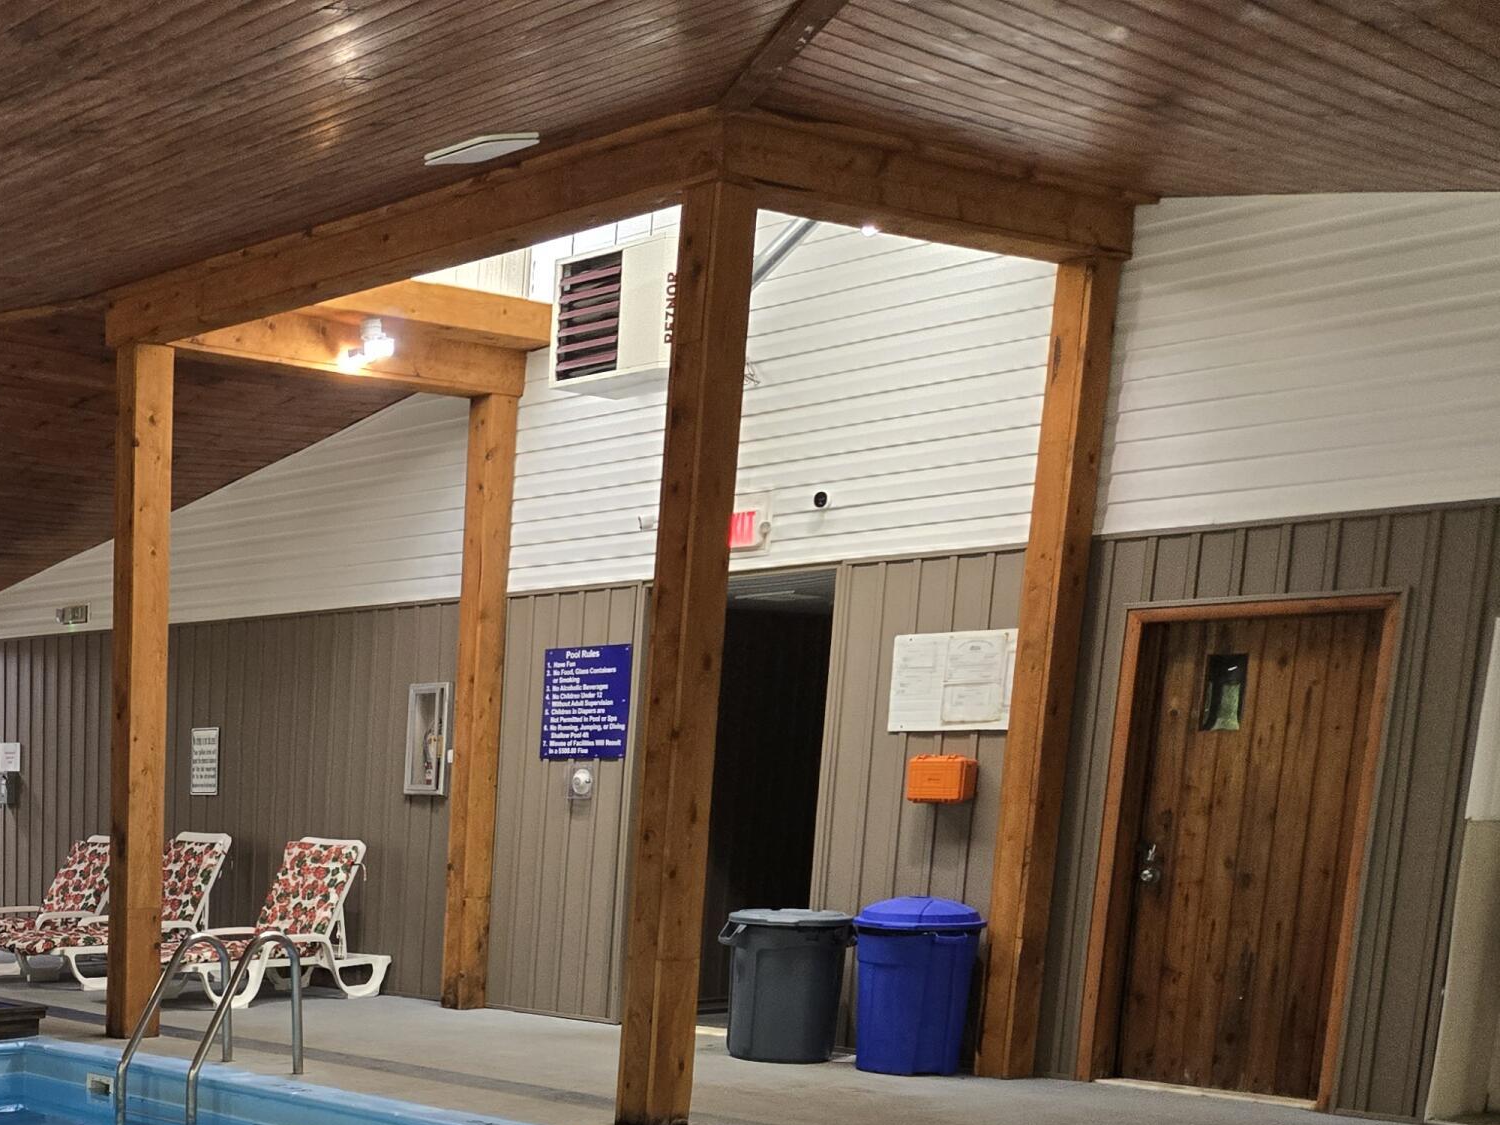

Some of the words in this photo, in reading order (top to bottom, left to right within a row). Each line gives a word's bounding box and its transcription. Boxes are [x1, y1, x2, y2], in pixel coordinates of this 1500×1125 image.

[566, 650, 580, 659] Pool
[581, 649, 600, 658] Rules
[609, 723, 625, 731] Diving
